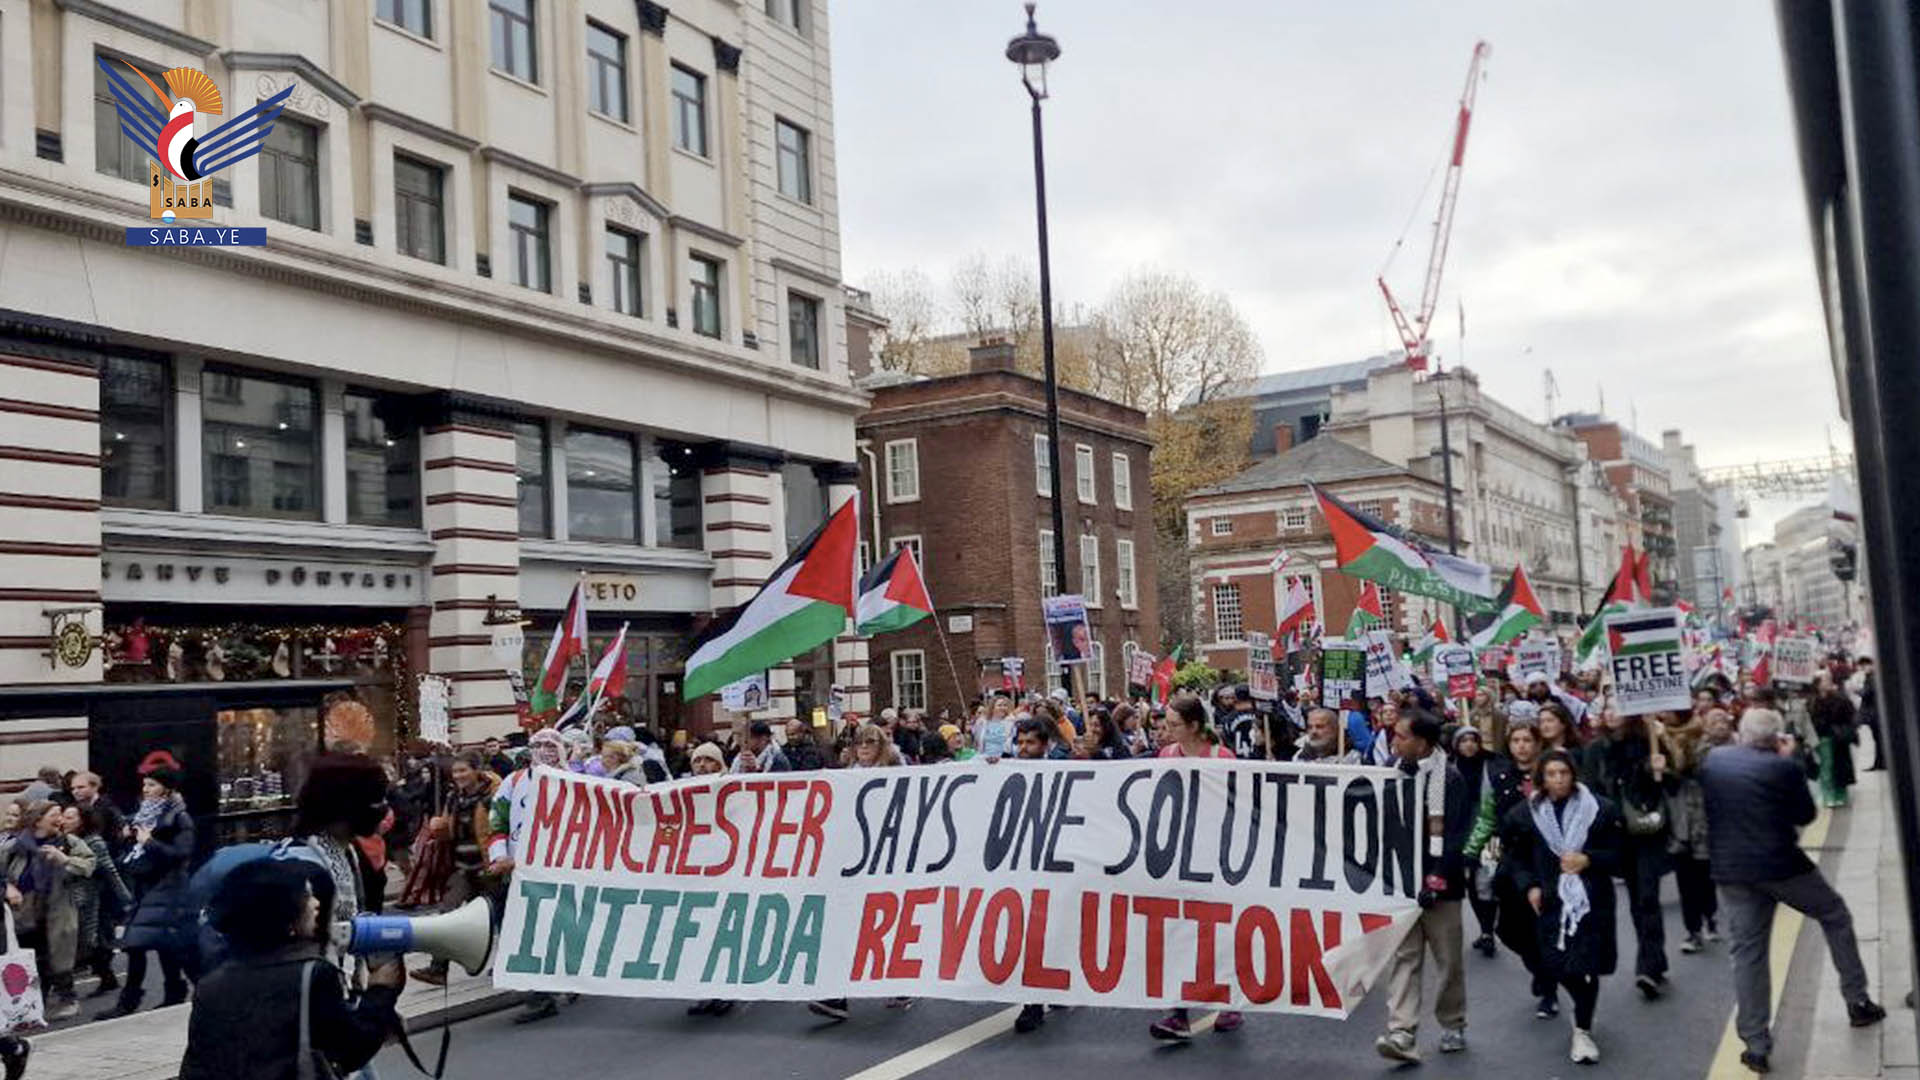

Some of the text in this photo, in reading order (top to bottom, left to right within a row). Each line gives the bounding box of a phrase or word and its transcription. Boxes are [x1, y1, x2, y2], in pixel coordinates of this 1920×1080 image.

[585, 583, 636, 600] 'ETO
[1613, 652, 1684, 682] FREE
[1616, 676, 1682, 694] PALESTINE
[525, 774, 833, 878] MANCHESTER
[840, 774, 978, 877] SAYS
[983, 770, 1095, 872] ONE
[1104, 768, 1416, 899] SOLUTION
[505, 880, 827, 985] INTIFADA
